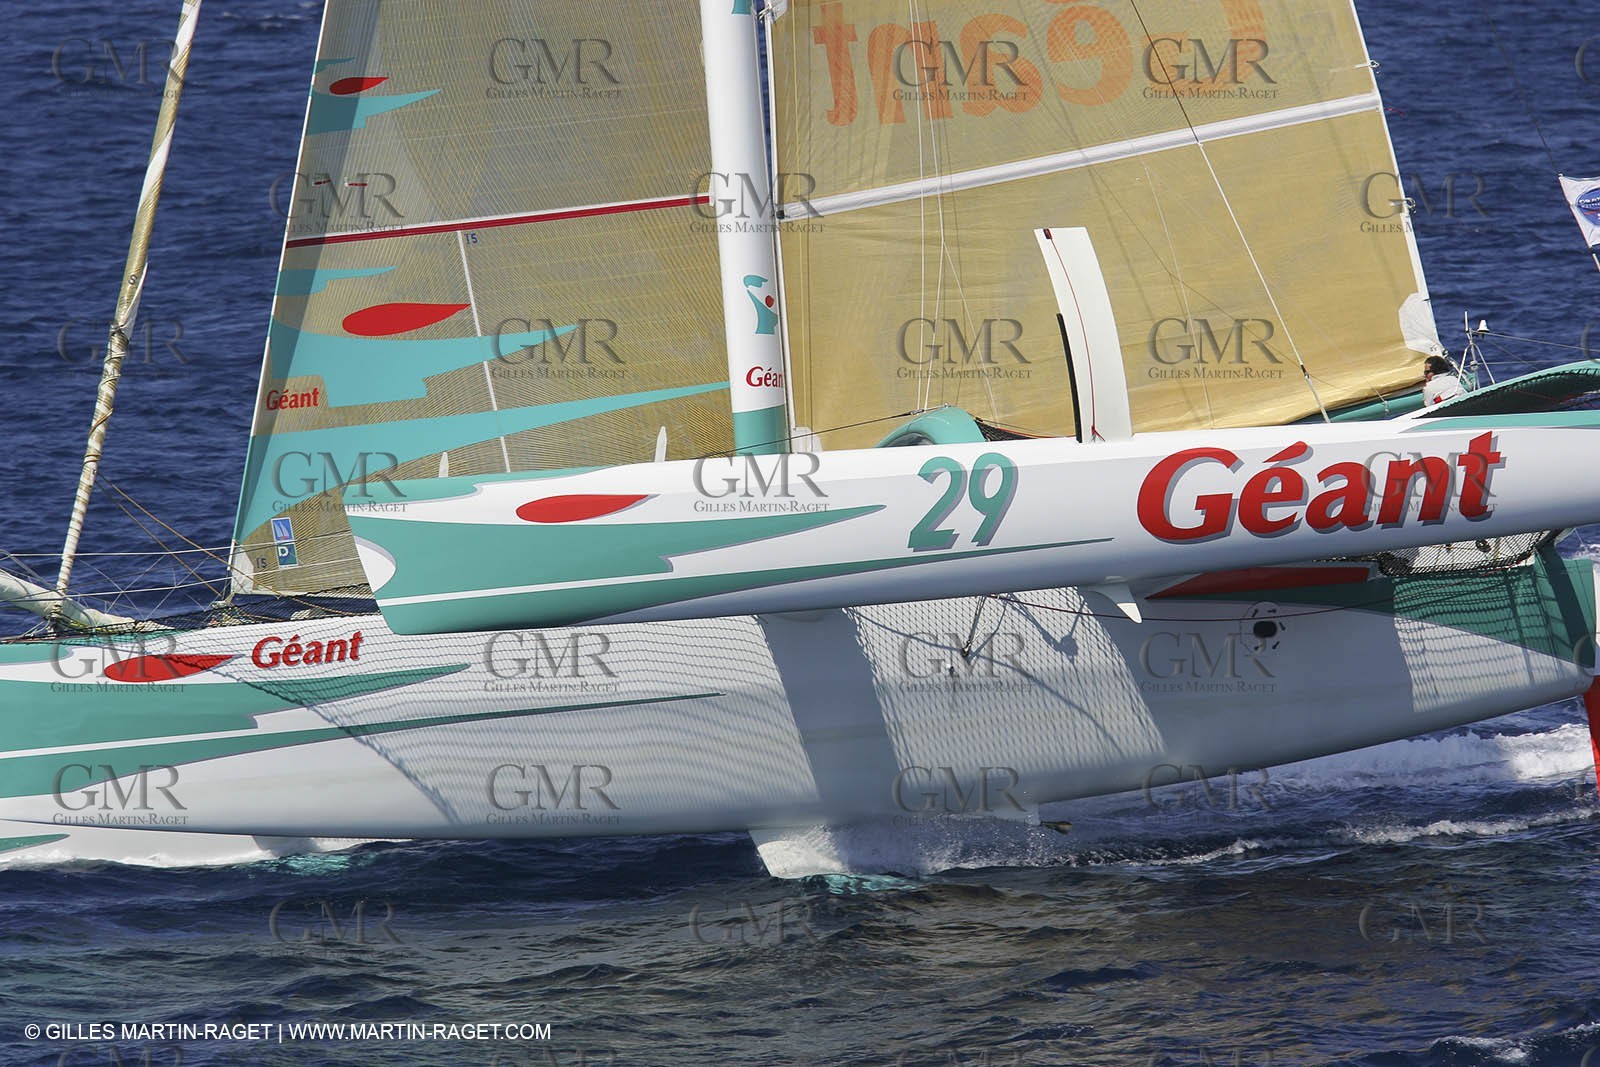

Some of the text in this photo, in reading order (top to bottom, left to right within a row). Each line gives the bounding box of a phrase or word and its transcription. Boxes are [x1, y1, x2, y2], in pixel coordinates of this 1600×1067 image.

[464, 232, 478, 245] 15
[266, 387, 319, 411] Géant
[907, 452, 1018, 552] 29
[1137, 431, 1505, 545] Géant
[255, 557, 267, 569] 15
[252, 630, 364, 669] Géant
